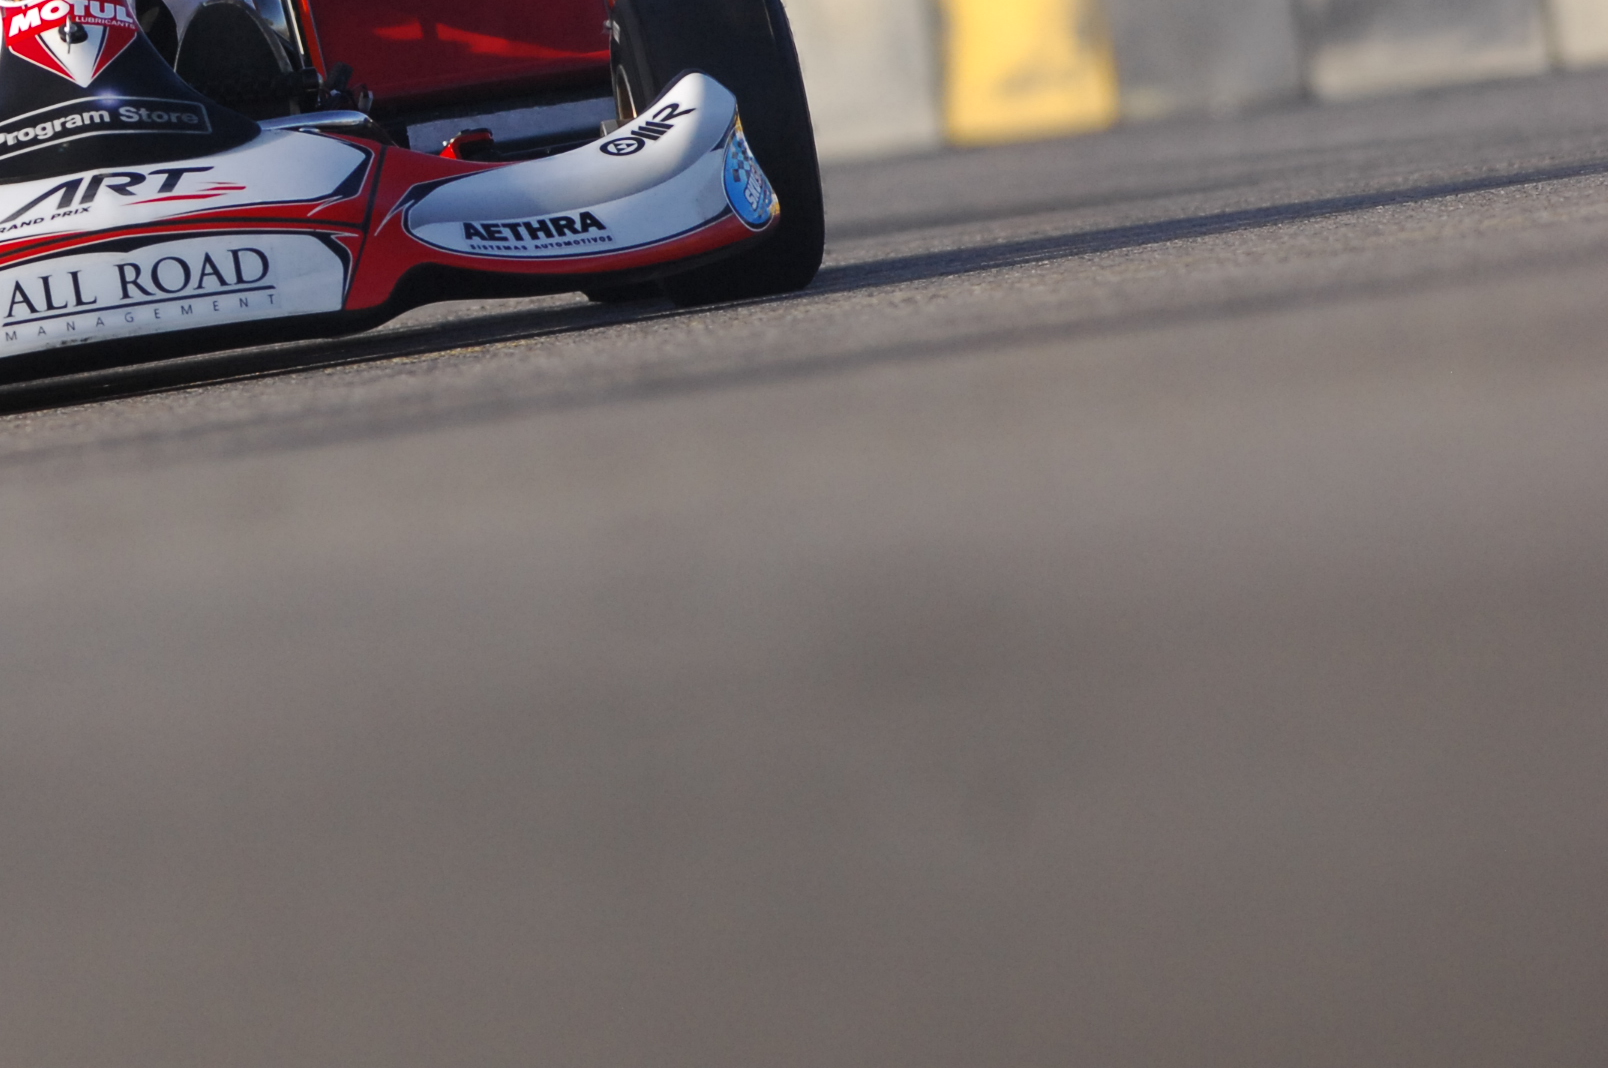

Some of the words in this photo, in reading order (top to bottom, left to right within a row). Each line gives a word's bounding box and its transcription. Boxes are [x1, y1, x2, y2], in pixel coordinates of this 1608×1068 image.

[75, 16, 136, 29] LUBRICANTS
[119, 106, 199, 125] Store
[51, 205, 92, 221] PRIX
[462, 211, 607, 241] AETHRA
[469, 243, 528, 251] SISTEMAS
[534, 235, 613, 250] AUTOMOTIVOS
[3, 270, 97, 319] ALL
[114, 247, 270, 301] ROAD
[5, 294, 276, 342] MANAGEMENT
